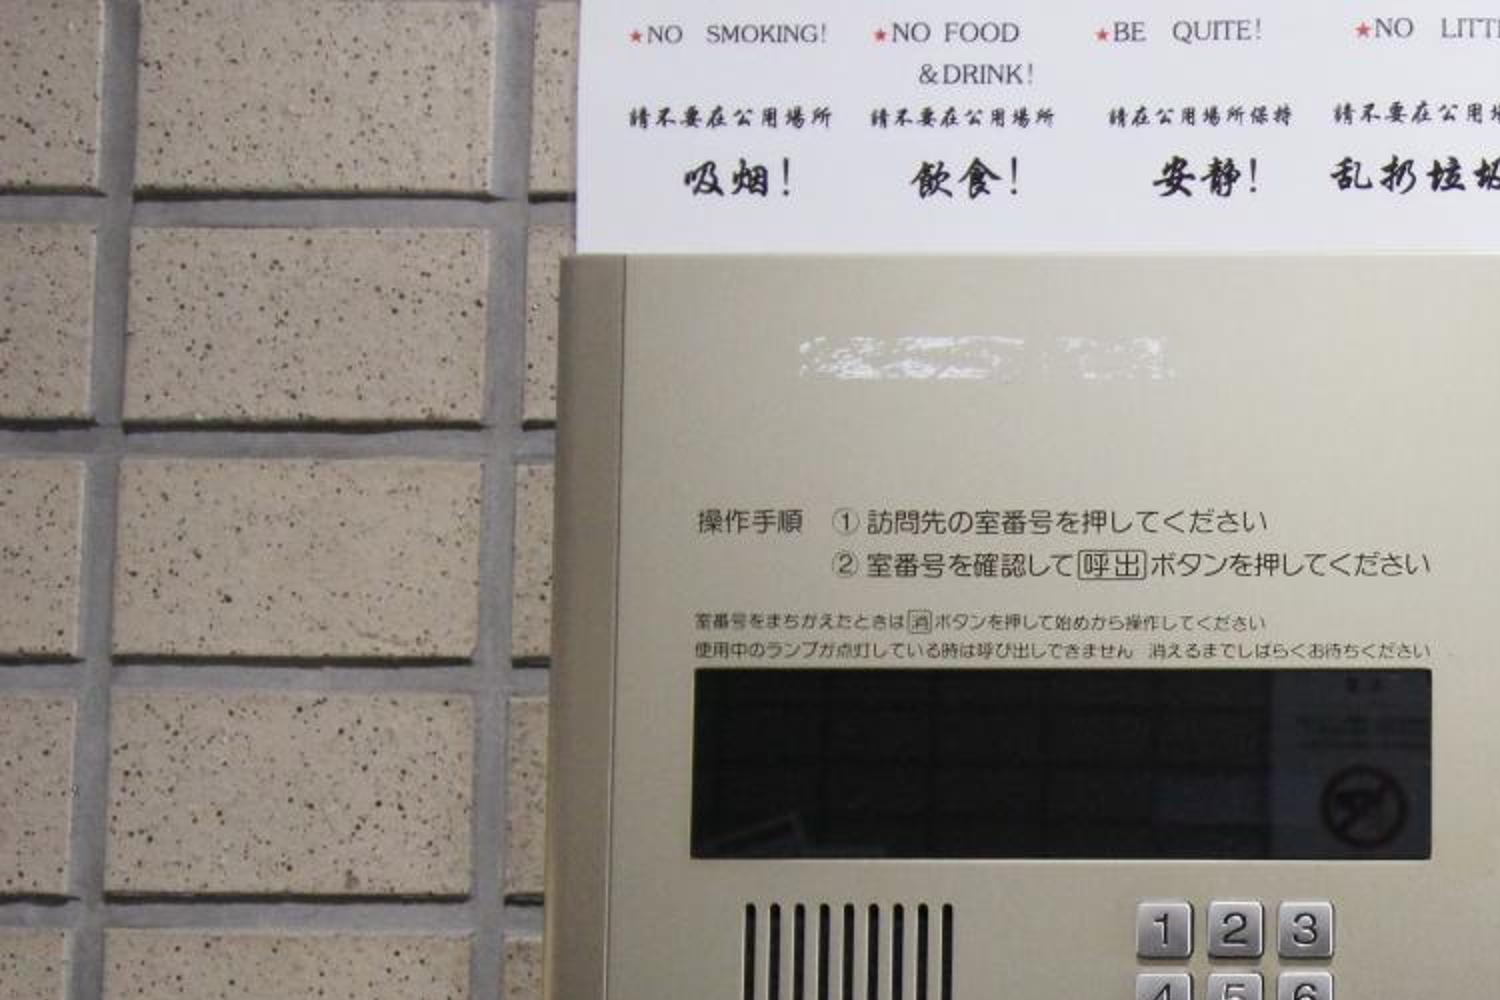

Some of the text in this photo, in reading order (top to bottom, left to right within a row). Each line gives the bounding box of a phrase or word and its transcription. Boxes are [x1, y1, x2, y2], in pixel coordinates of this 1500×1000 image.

[647, 25, 828, 45] NO SMOKING!
[892, 22, 1020, 43] NO FOOD
[1113, 20, 1262, 43] BE QUITE!
[1375, 18, 1414, 37] NO
[699, 509, 804, 535] 操作手順
[1154, 912, 1170, 945] 1
[1222, 912, 1248, 946] 2
[1292, 912, 1318, 946] 3
